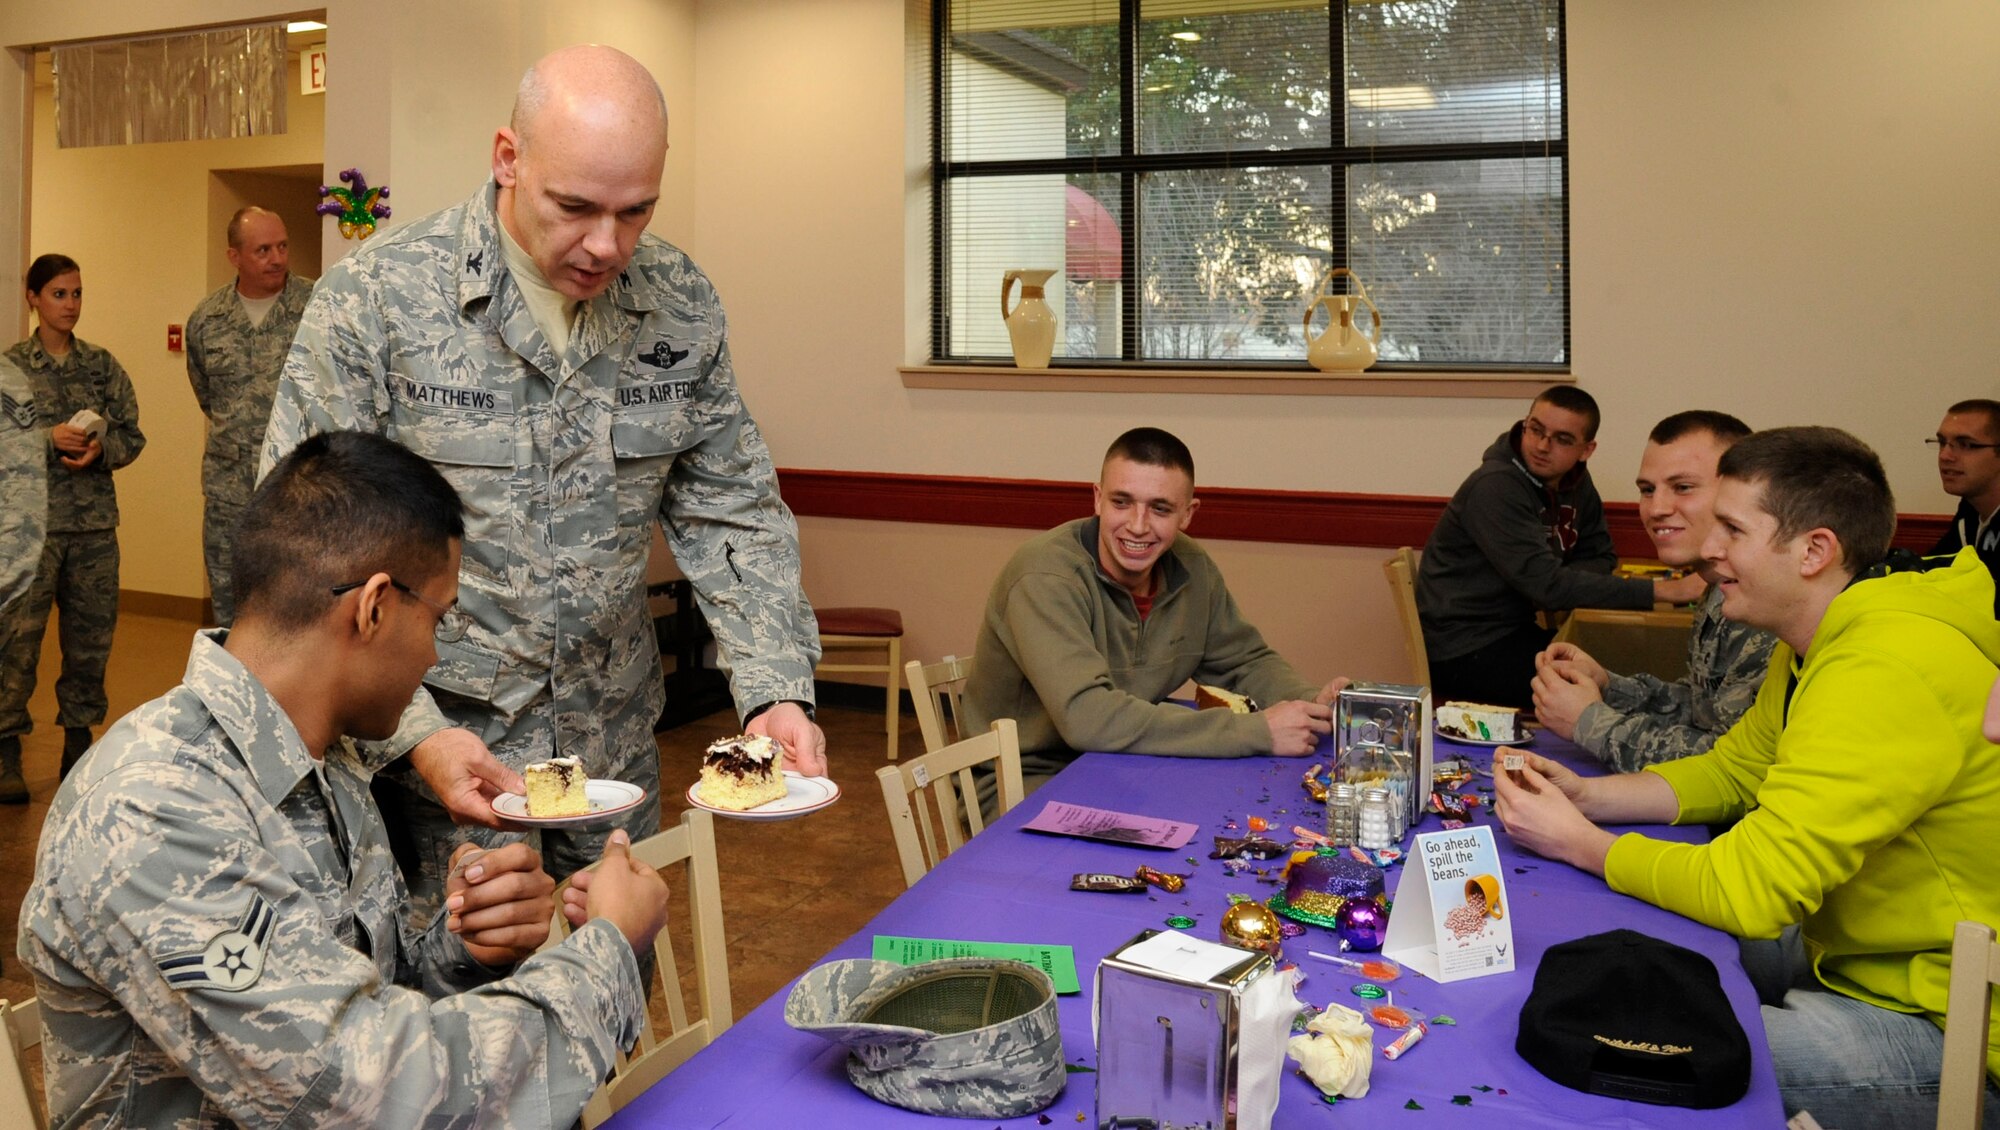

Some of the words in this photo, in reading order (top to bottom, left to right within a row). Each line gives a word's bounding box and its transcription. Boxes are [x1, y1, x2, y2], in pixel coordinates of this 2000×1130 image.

[406, 381, 495, 409] MATTHEWS
[620, 388, 645, 406] U.S.
[649, 383, 672, 403] AIR
[674, 380, 699, 399] FOR
[1425, 841, 1440, 853] Go
[1444, 834, 1480, 851] ahead,
[1429, 852, 1453, 869] spill
[1455, 850, 1473, 863] the
[1432, 868, 1469, 881] beans.
